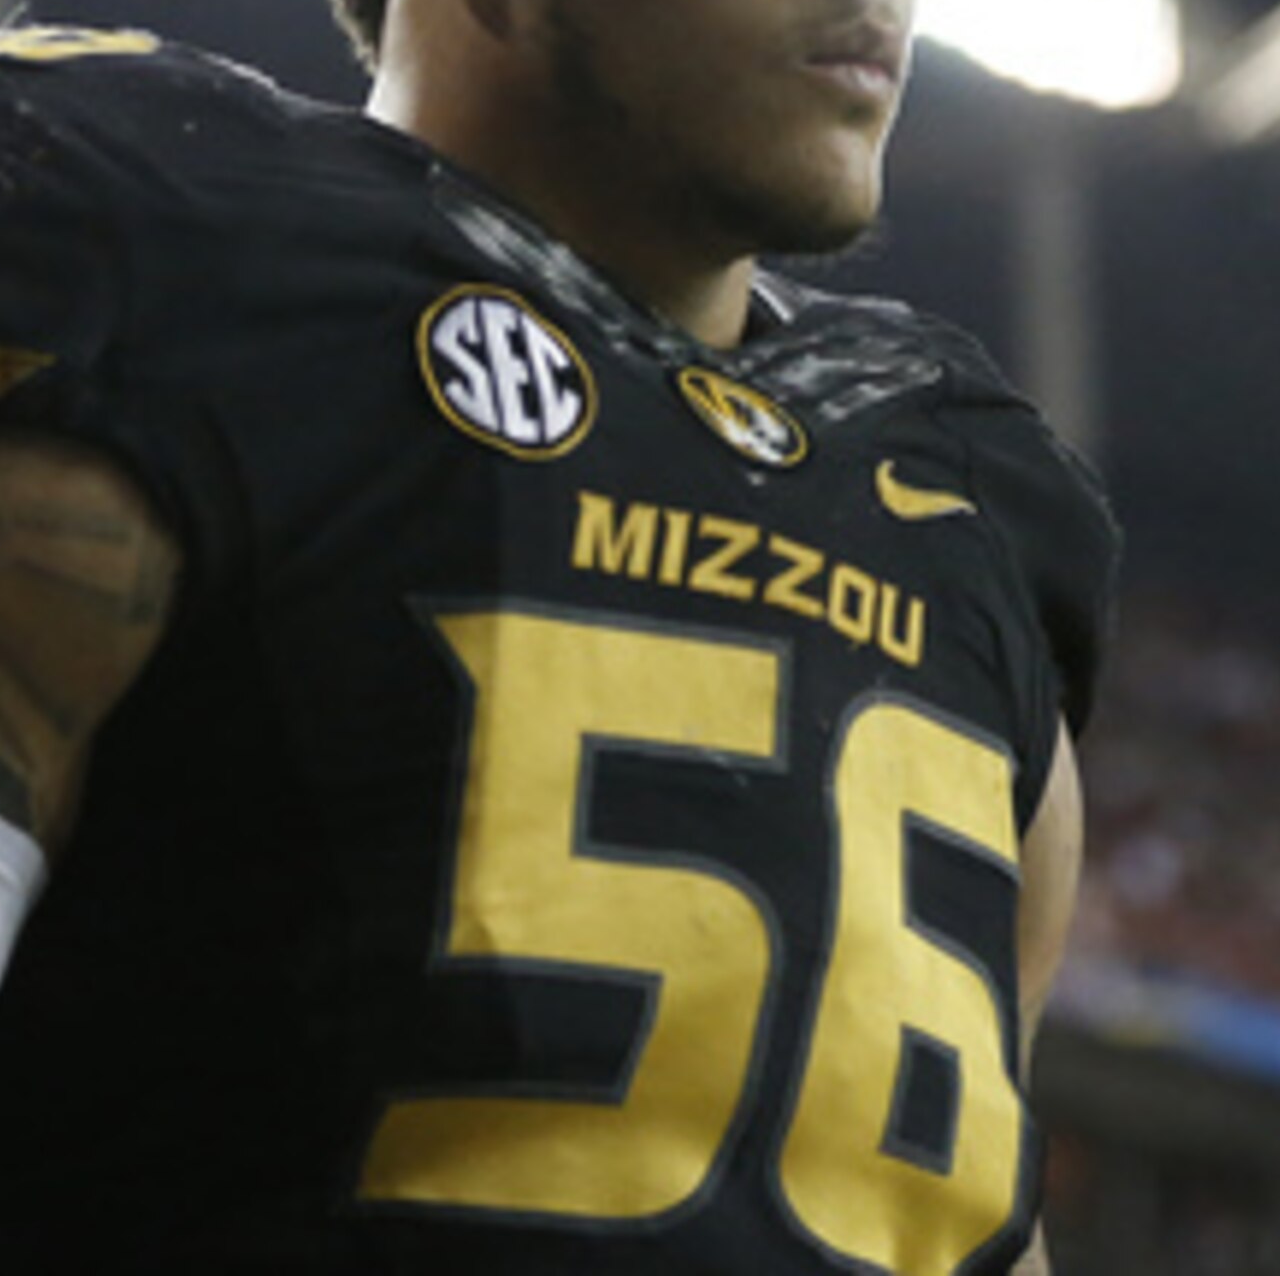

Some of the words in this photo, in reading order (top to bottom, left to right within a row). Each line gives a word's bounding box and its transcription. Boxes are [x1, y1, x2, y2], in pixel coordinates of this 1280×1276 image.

[431, 297, 583, 444] SEC
[571, 491, 925, 666] MIZZOU
[356, 608, 1024, 1276] 56
